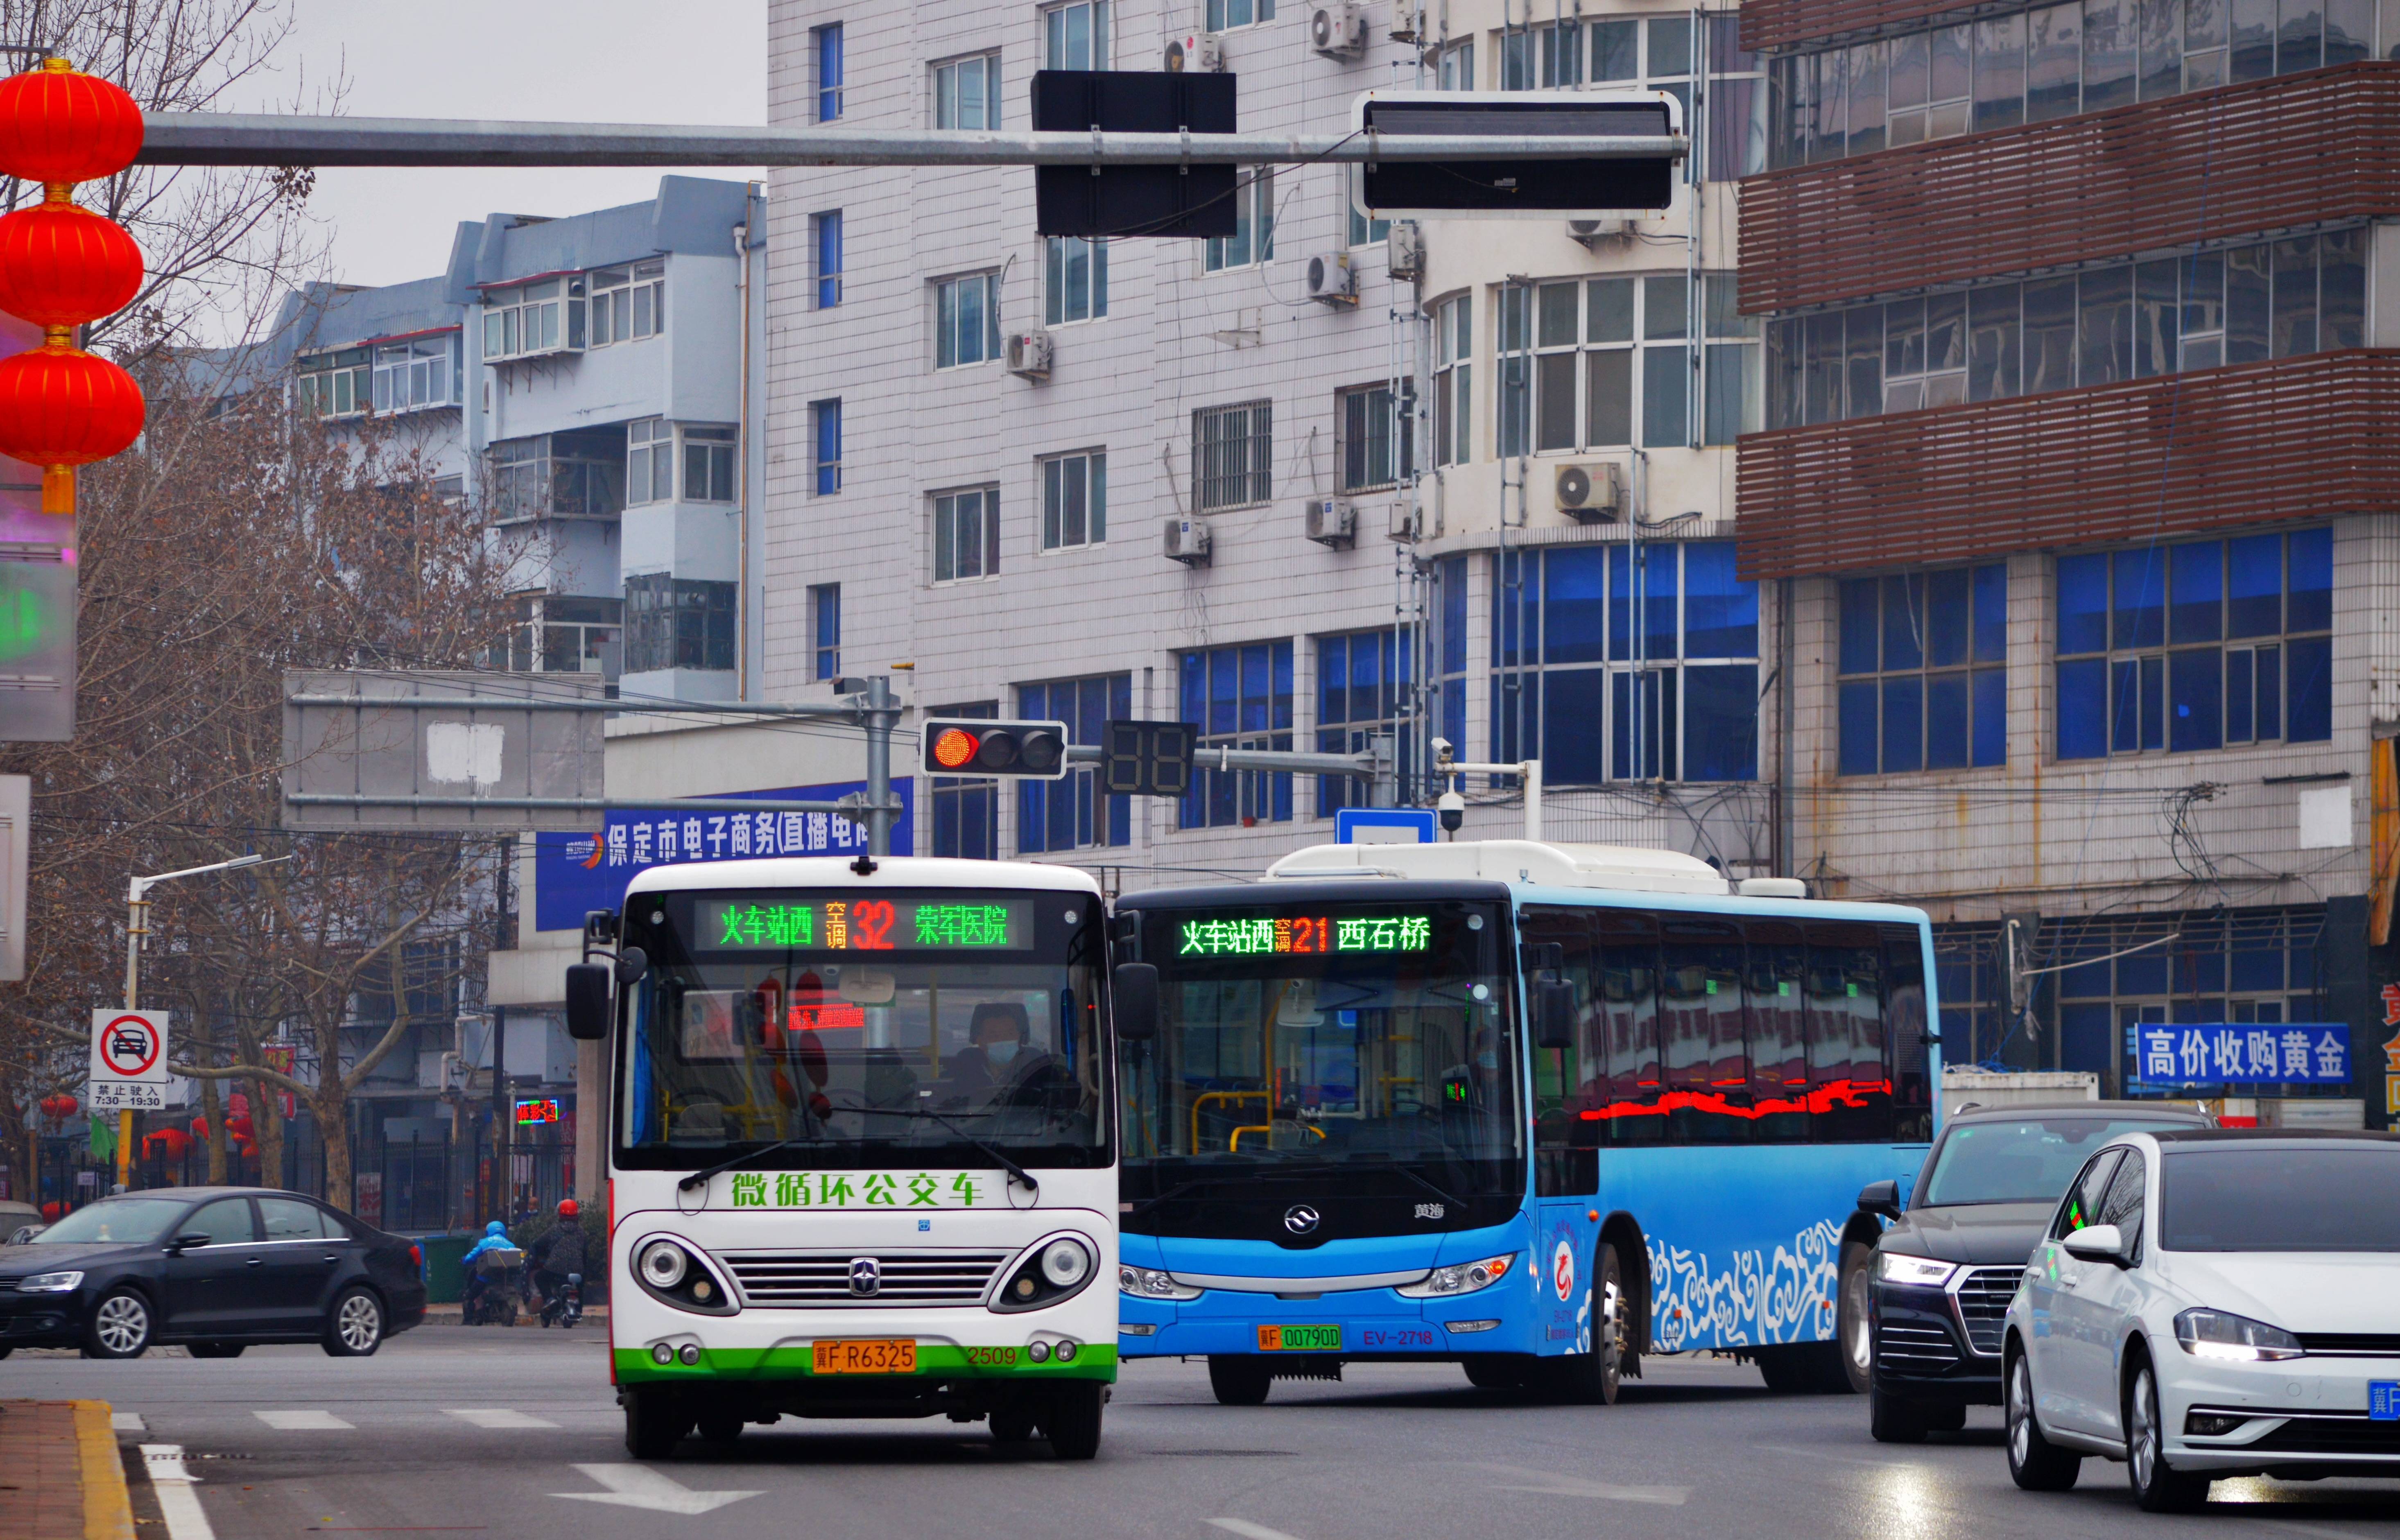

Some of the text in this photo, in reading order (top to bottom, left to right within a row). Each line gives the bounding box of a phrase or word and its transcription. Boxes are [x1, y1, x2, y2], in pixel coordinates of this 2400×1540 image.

[720, 901, 1007, 950] 火车站西 空调 32 荣军医院
[1181, 916, 1430, 954] 火车站西 空调 21 西石桥
[2145, 1029, 2345, 1078] 高价收购黄金
[98, 1084, 158, 1097] 禁止驶入
[731, 1173, 984, 1206] 微循环公交车
[1414, 1203, 1444, 1219] 黄海
[1364, 1331, 1432, 1346] EV-2718
[967, 1347, 1016, 1365] 2509
